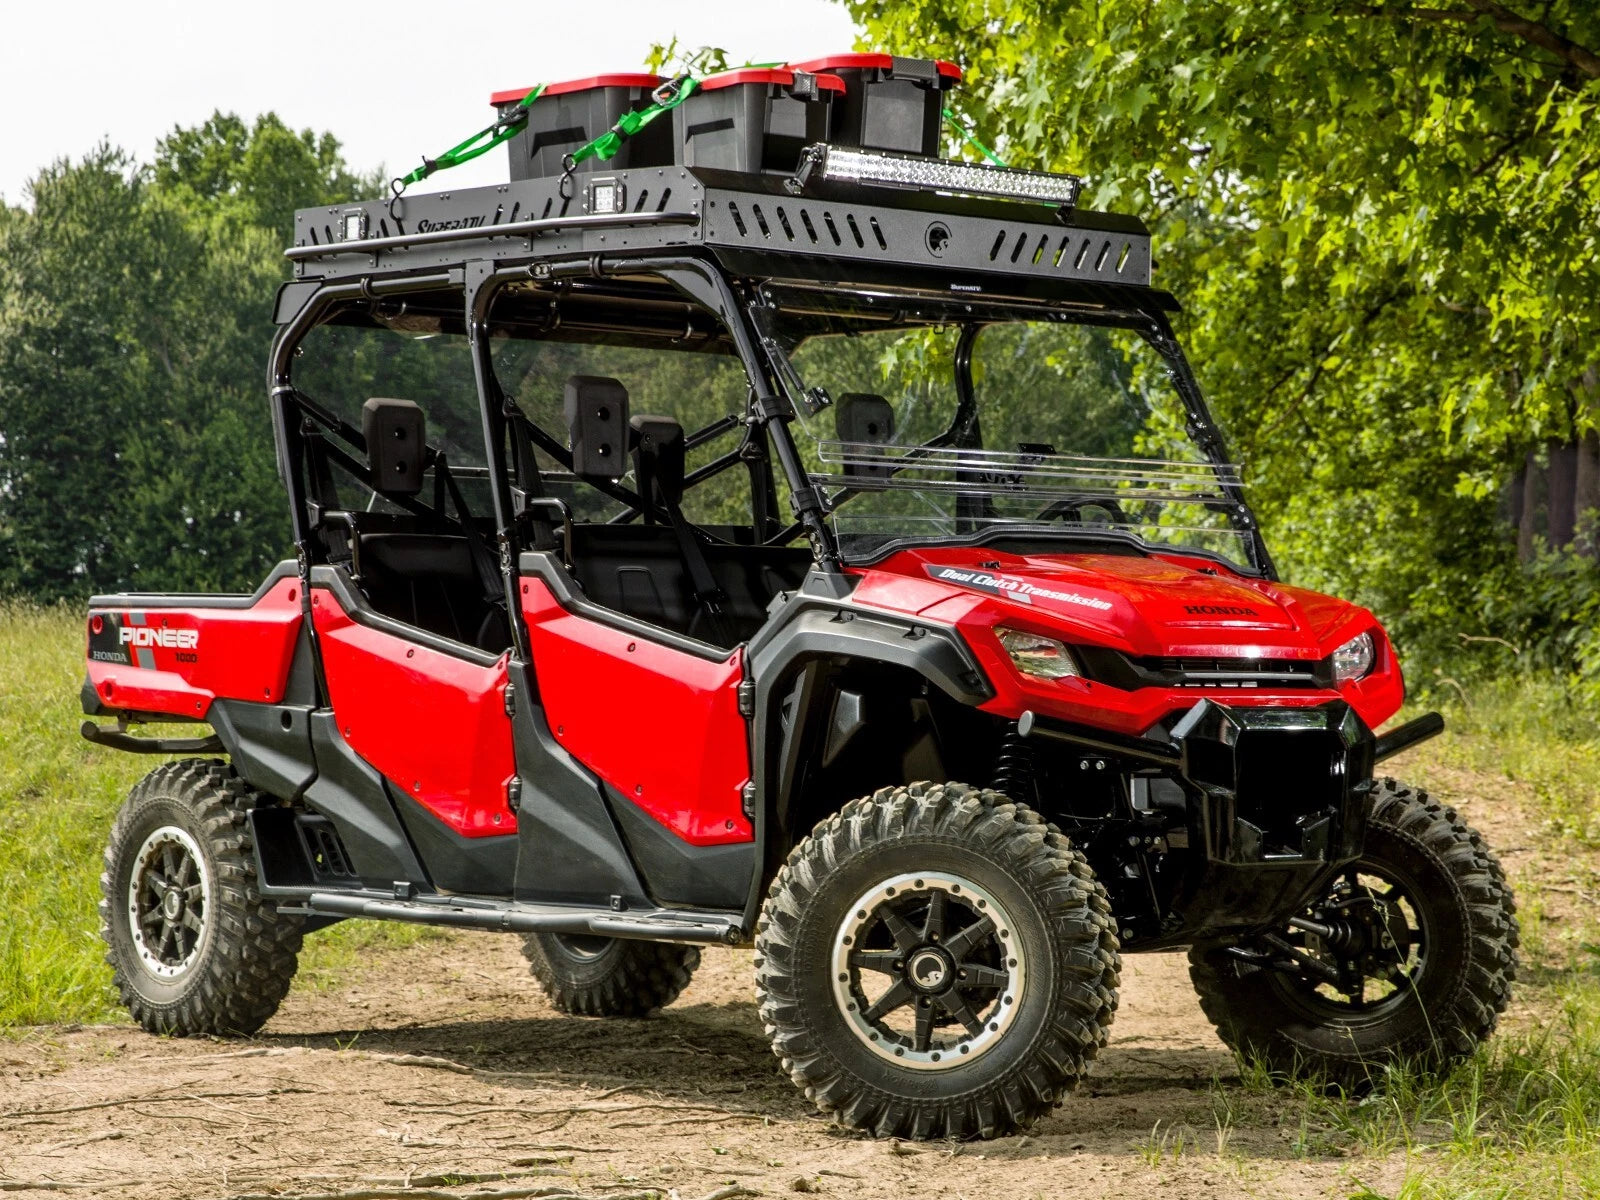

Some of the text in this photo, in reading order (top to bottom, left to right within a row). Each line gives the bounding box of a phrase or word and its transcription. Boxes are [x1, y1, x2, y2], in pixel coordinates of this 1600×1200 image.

[938, 568, 1113, 611] Dual Clutch Transmission
[1183, 605, 1259, 616] HONDA
[119, 626, 199, 649] PIONEER
[93, 650, 128, 663] HONDA
[175, 652, 198, 663] 1000
